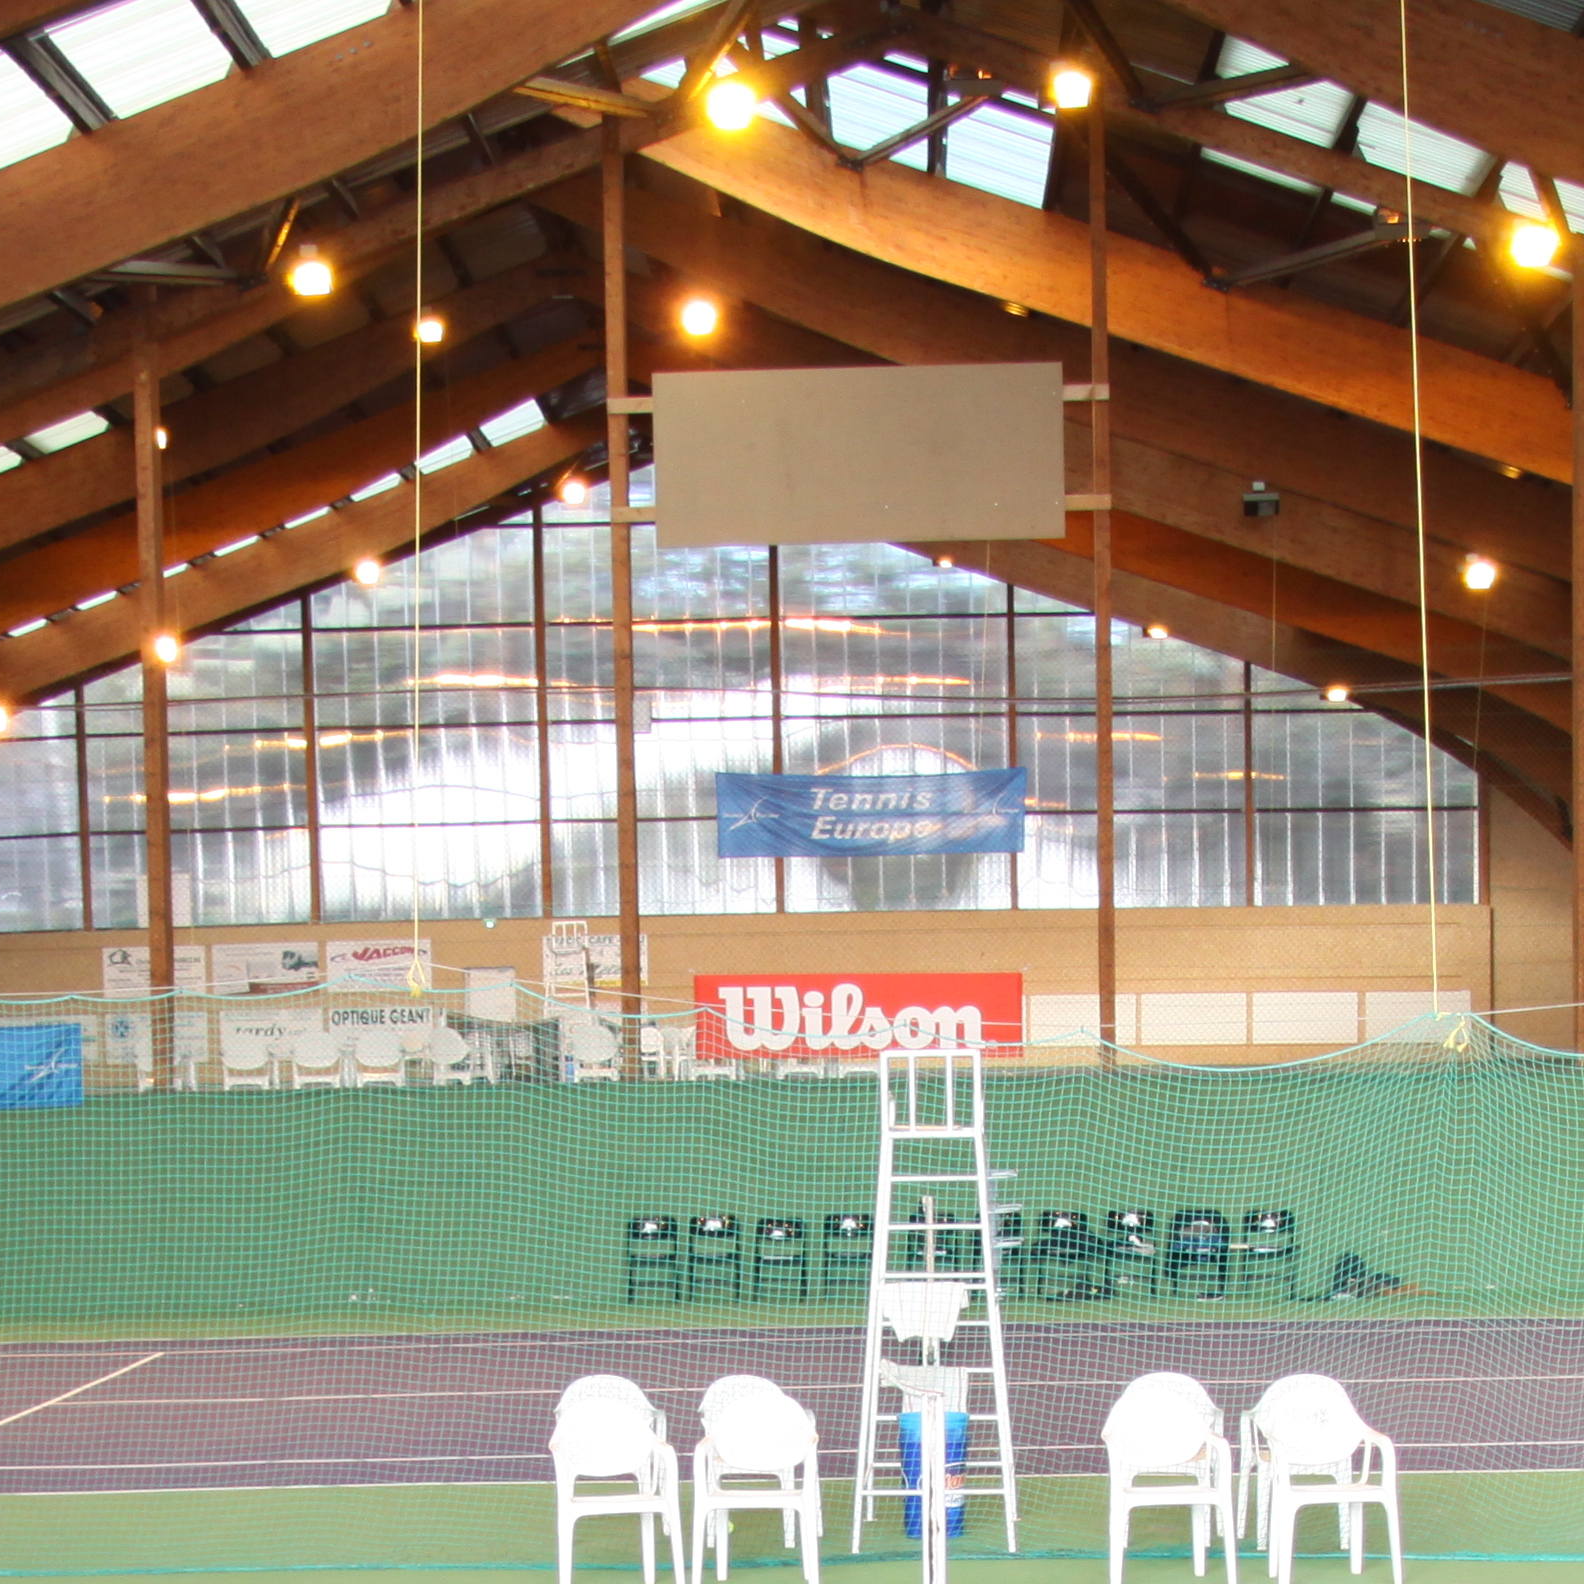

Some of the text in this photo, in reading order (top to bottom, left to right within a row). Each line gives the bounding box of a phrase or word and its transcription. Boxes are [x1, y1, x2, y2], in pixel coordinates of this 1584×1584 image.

[811, 788, 932, 811] Tennis
[811, 816, 934, 843] Europe
[331, 1007, 431, 1026] OPTIQUE GEANT
[718, 983, 985, 1051] Wilson
